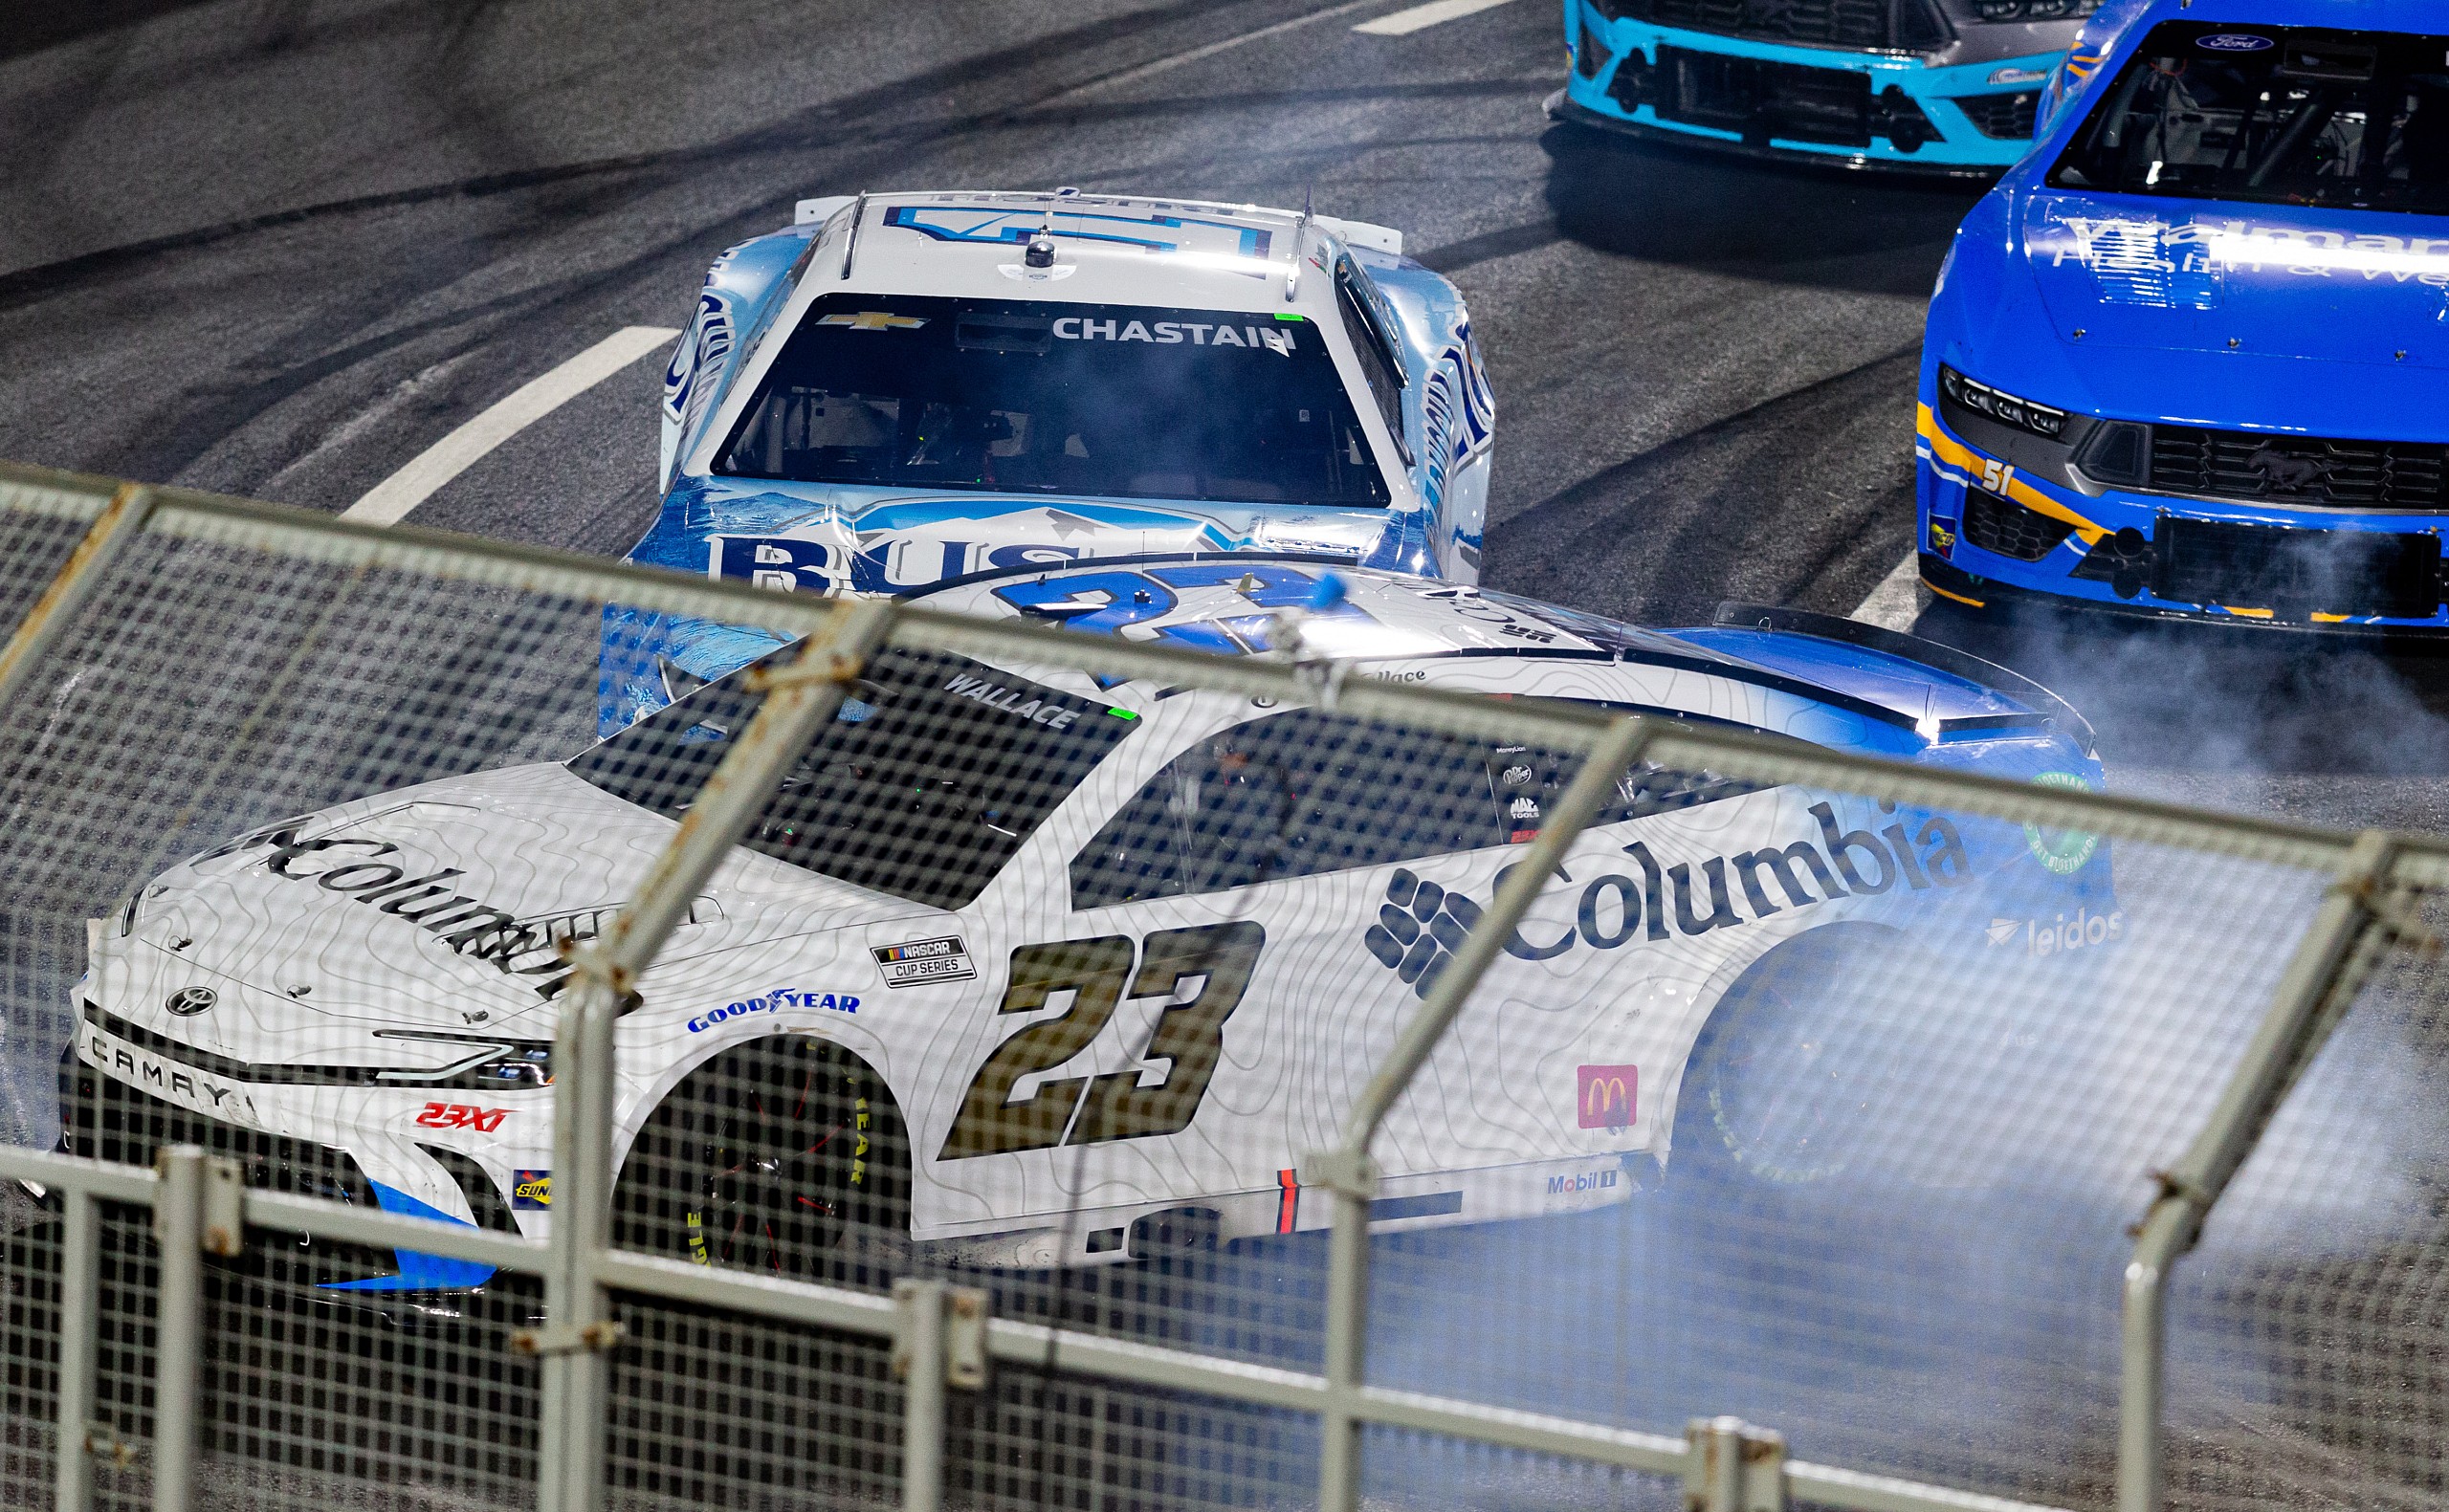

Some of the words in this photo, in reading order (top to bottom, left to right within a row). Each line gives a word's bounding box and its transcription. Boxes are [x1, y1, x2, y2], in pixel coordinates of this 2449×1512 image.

[2210, 34, 2257, 49] Ford
[1053, 318, 1296, 350] CHASTAIN
[1982, 459, 2015, 496] 51
[943, 673, 1081, 729] WALLACE
[1492, 798, 1975, 960] Columbia
[2028, 908, 2124, 956] leidos
[903, 942, 951, 958] NASCAR
[895, 964, 917, 976] CUP
[920, 959, 959, 974] SERIES
[687, 989, 861, 1033] GOODYEAR
[936, 920, 1267, 1161] 23
[518, 1184, 552, 1196] SUN
[1548, 1172, 1598, 1194] Mobil
